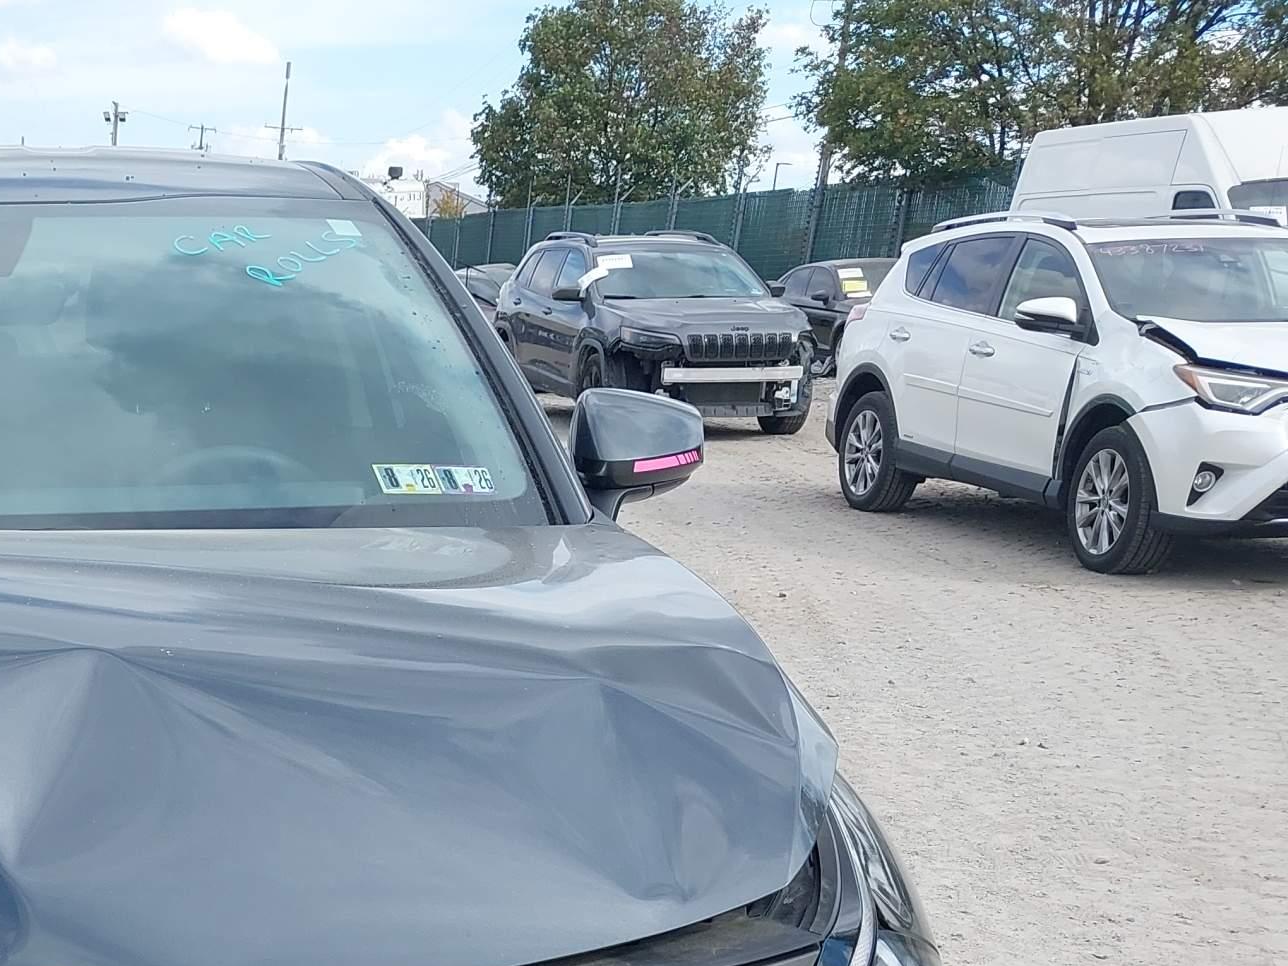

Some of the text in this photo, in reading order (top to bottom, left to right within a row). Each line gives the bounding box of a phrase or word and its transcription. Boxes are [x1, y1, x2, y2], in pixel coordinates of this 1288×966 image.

[173, 225, 272, 255] CAR
[246, 231, 357, 287] ROLLS
[730, 324, 750, 333] Jeep
[416, 468, 436, 489] 26
[474, 469, 494, 490] 26
